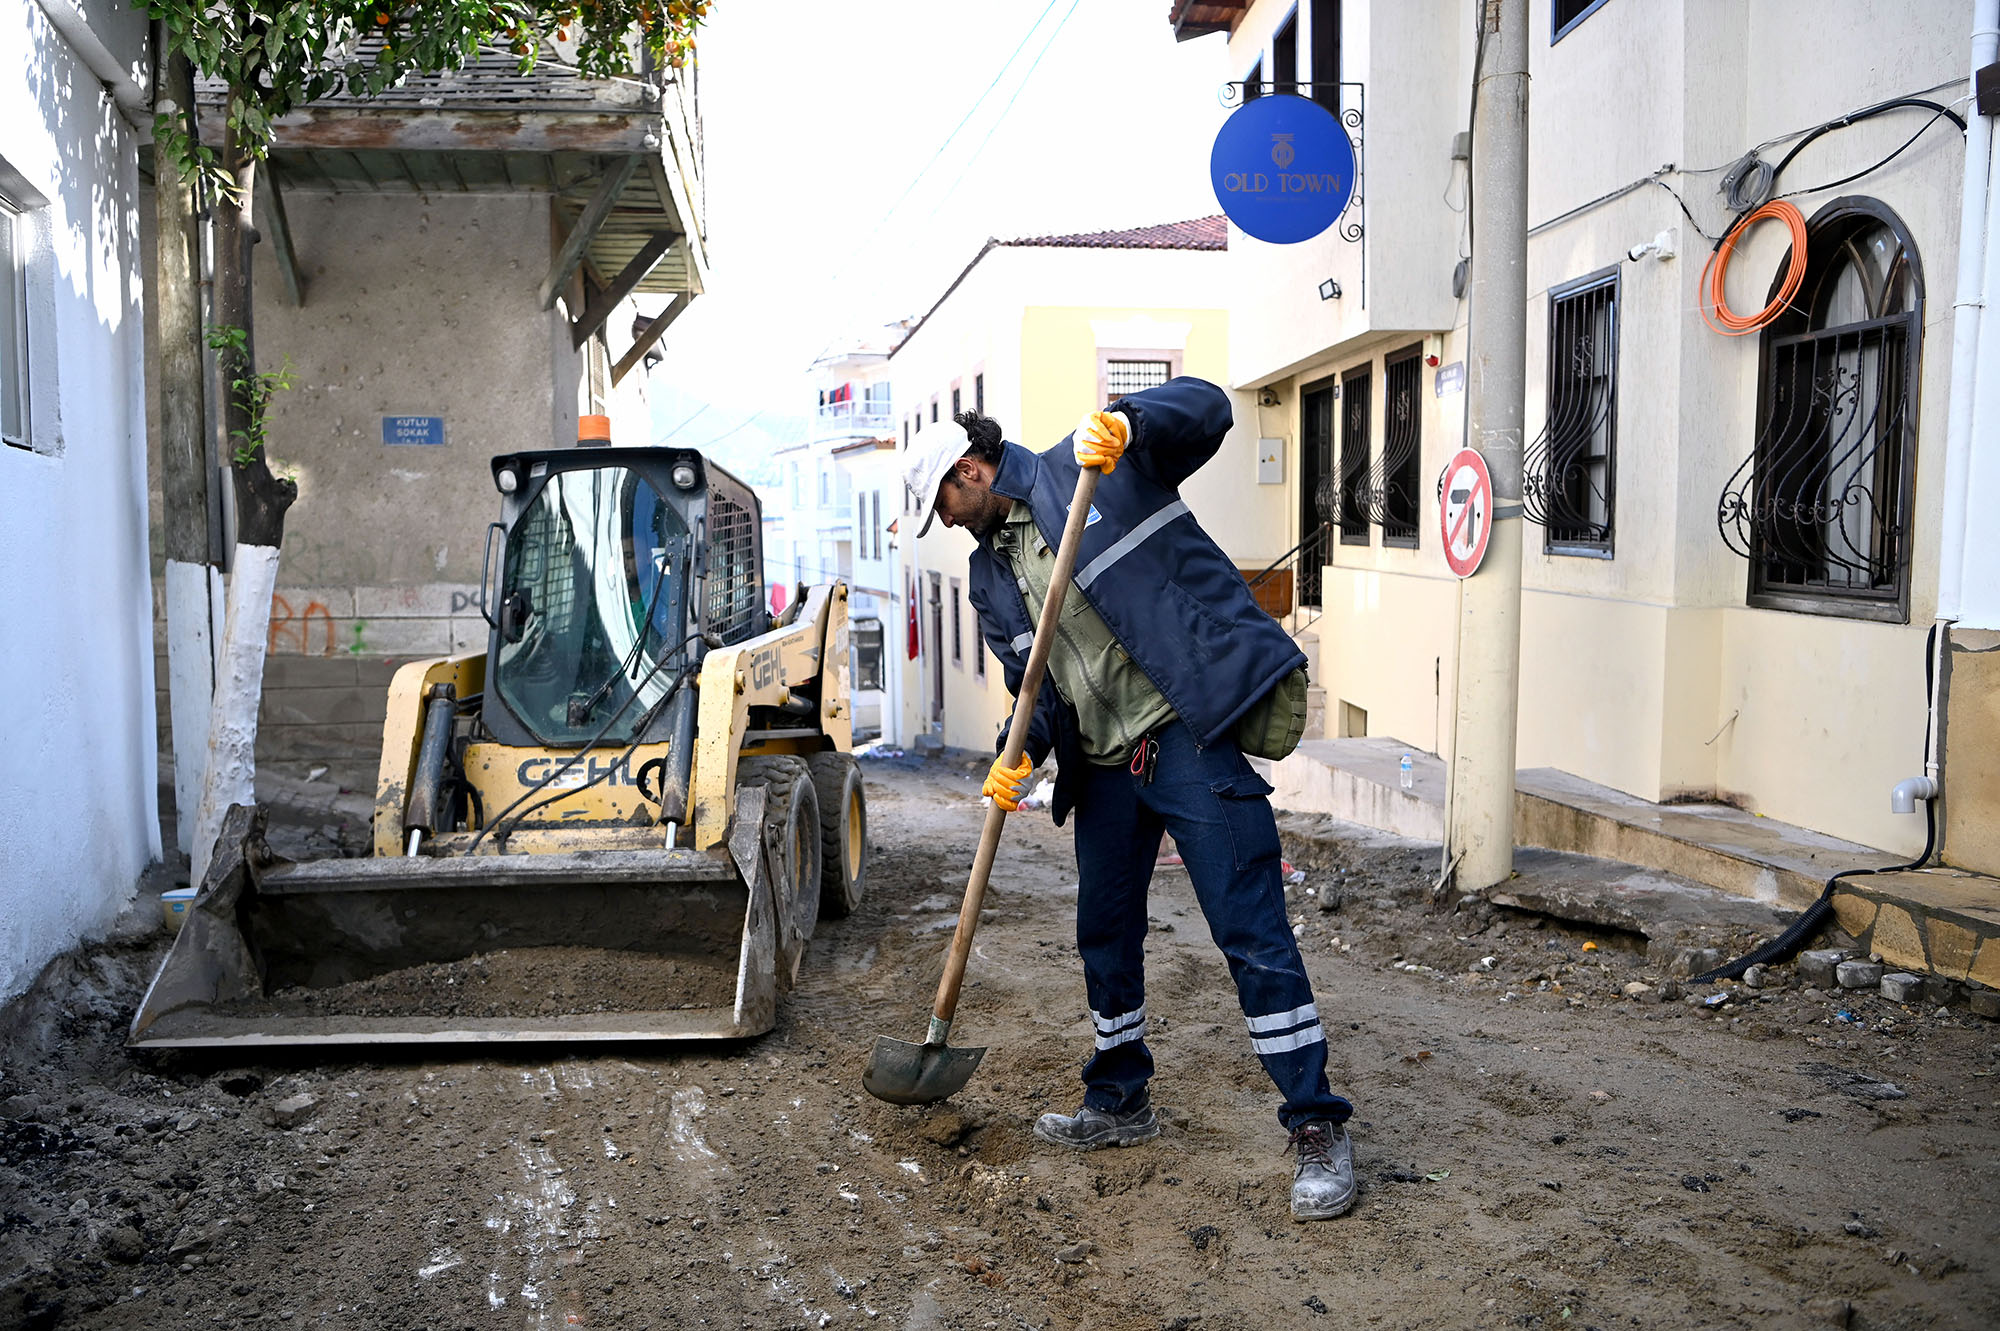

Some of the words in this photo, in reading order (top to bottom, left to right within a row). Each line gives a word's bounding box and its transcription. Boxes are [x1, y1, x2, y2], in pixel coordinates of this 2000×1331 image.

[1224, 173, 1268, 192] OLD
[1277, 173, 1341, 192] TOWN
[397, 418, 429, 427] KUTLU
[397, 428, 430, 437] SOKAK
[752, 646, 787, 690] GEHL
[517, 756, 639, 788] GEHL
